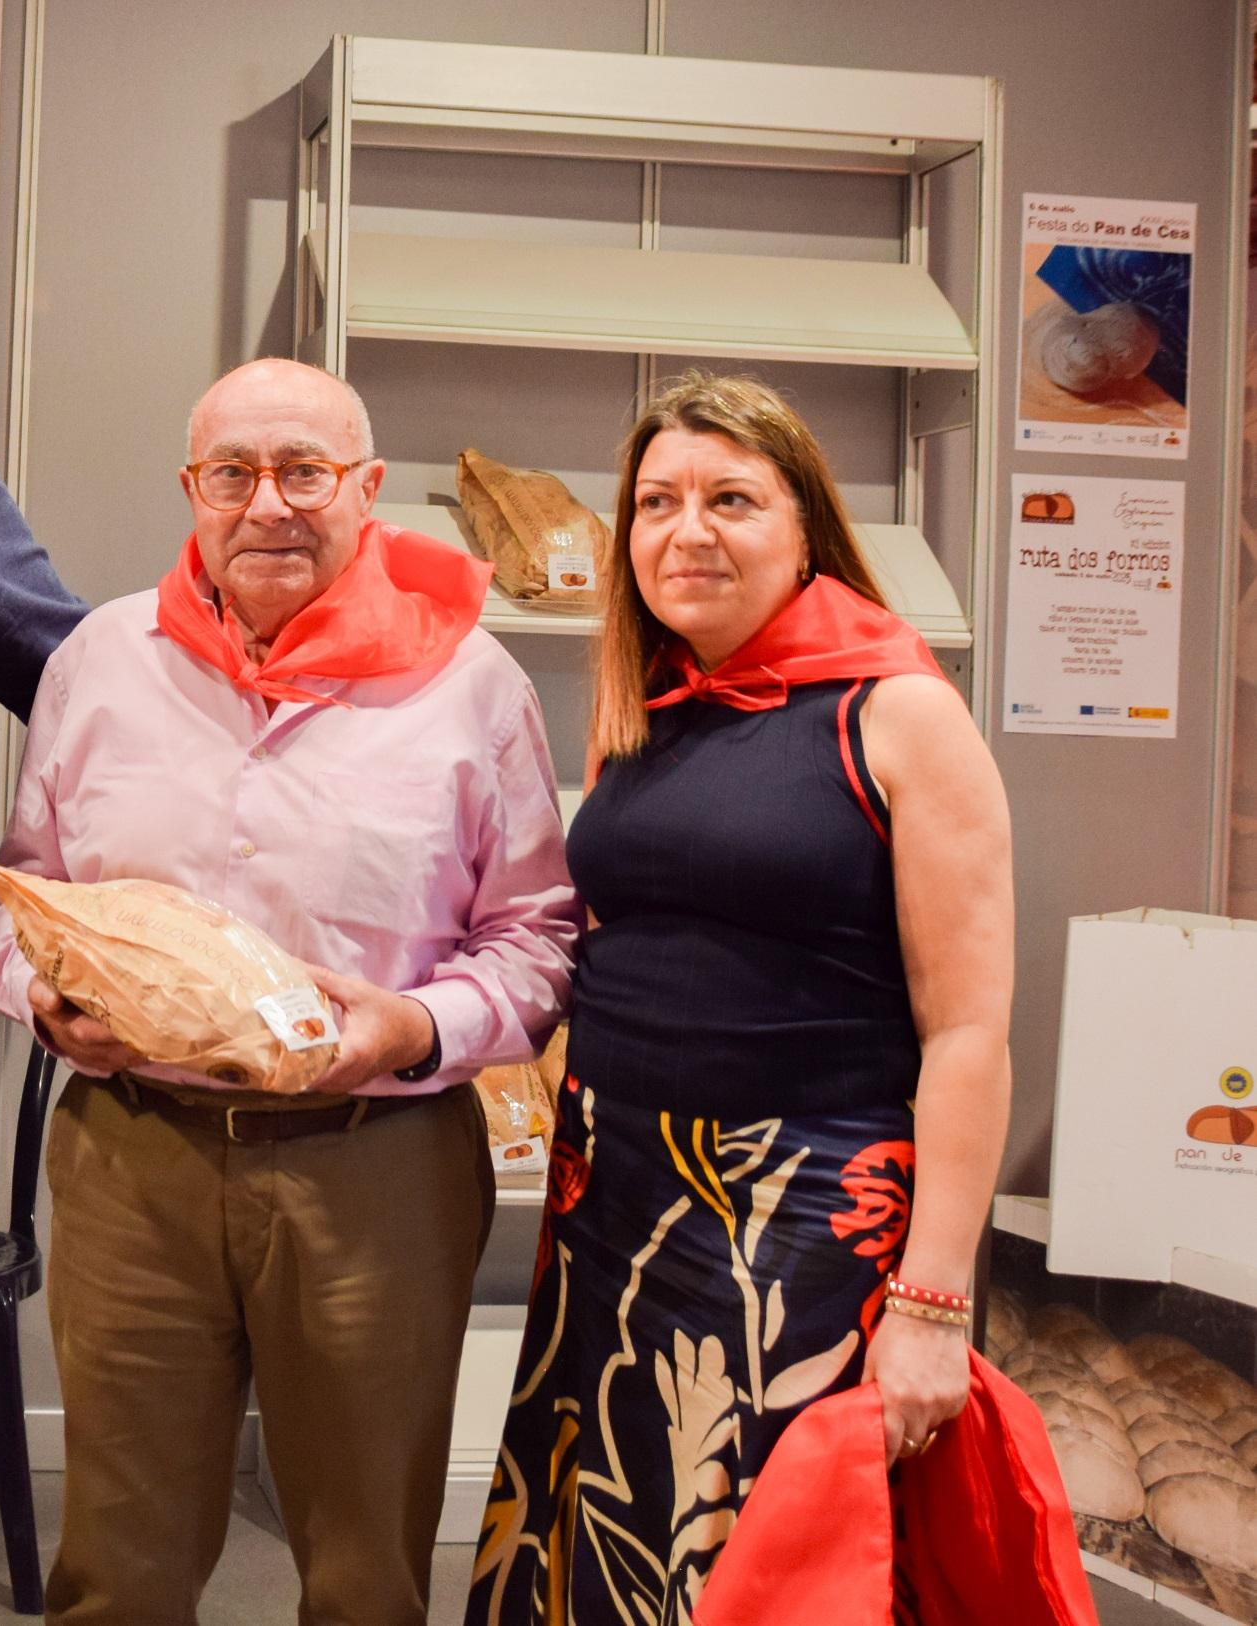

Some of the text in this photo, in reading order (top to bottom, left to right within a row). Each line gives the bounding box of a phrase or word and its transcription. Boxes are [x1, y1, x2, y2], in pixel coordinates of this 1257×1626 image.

[1027, 216, 1191, 240] Festa do Pan de Cea
[1020, 546, 1170, 573] ruta dos fornos
[1174, 1146, 1243, 1162] pan de
